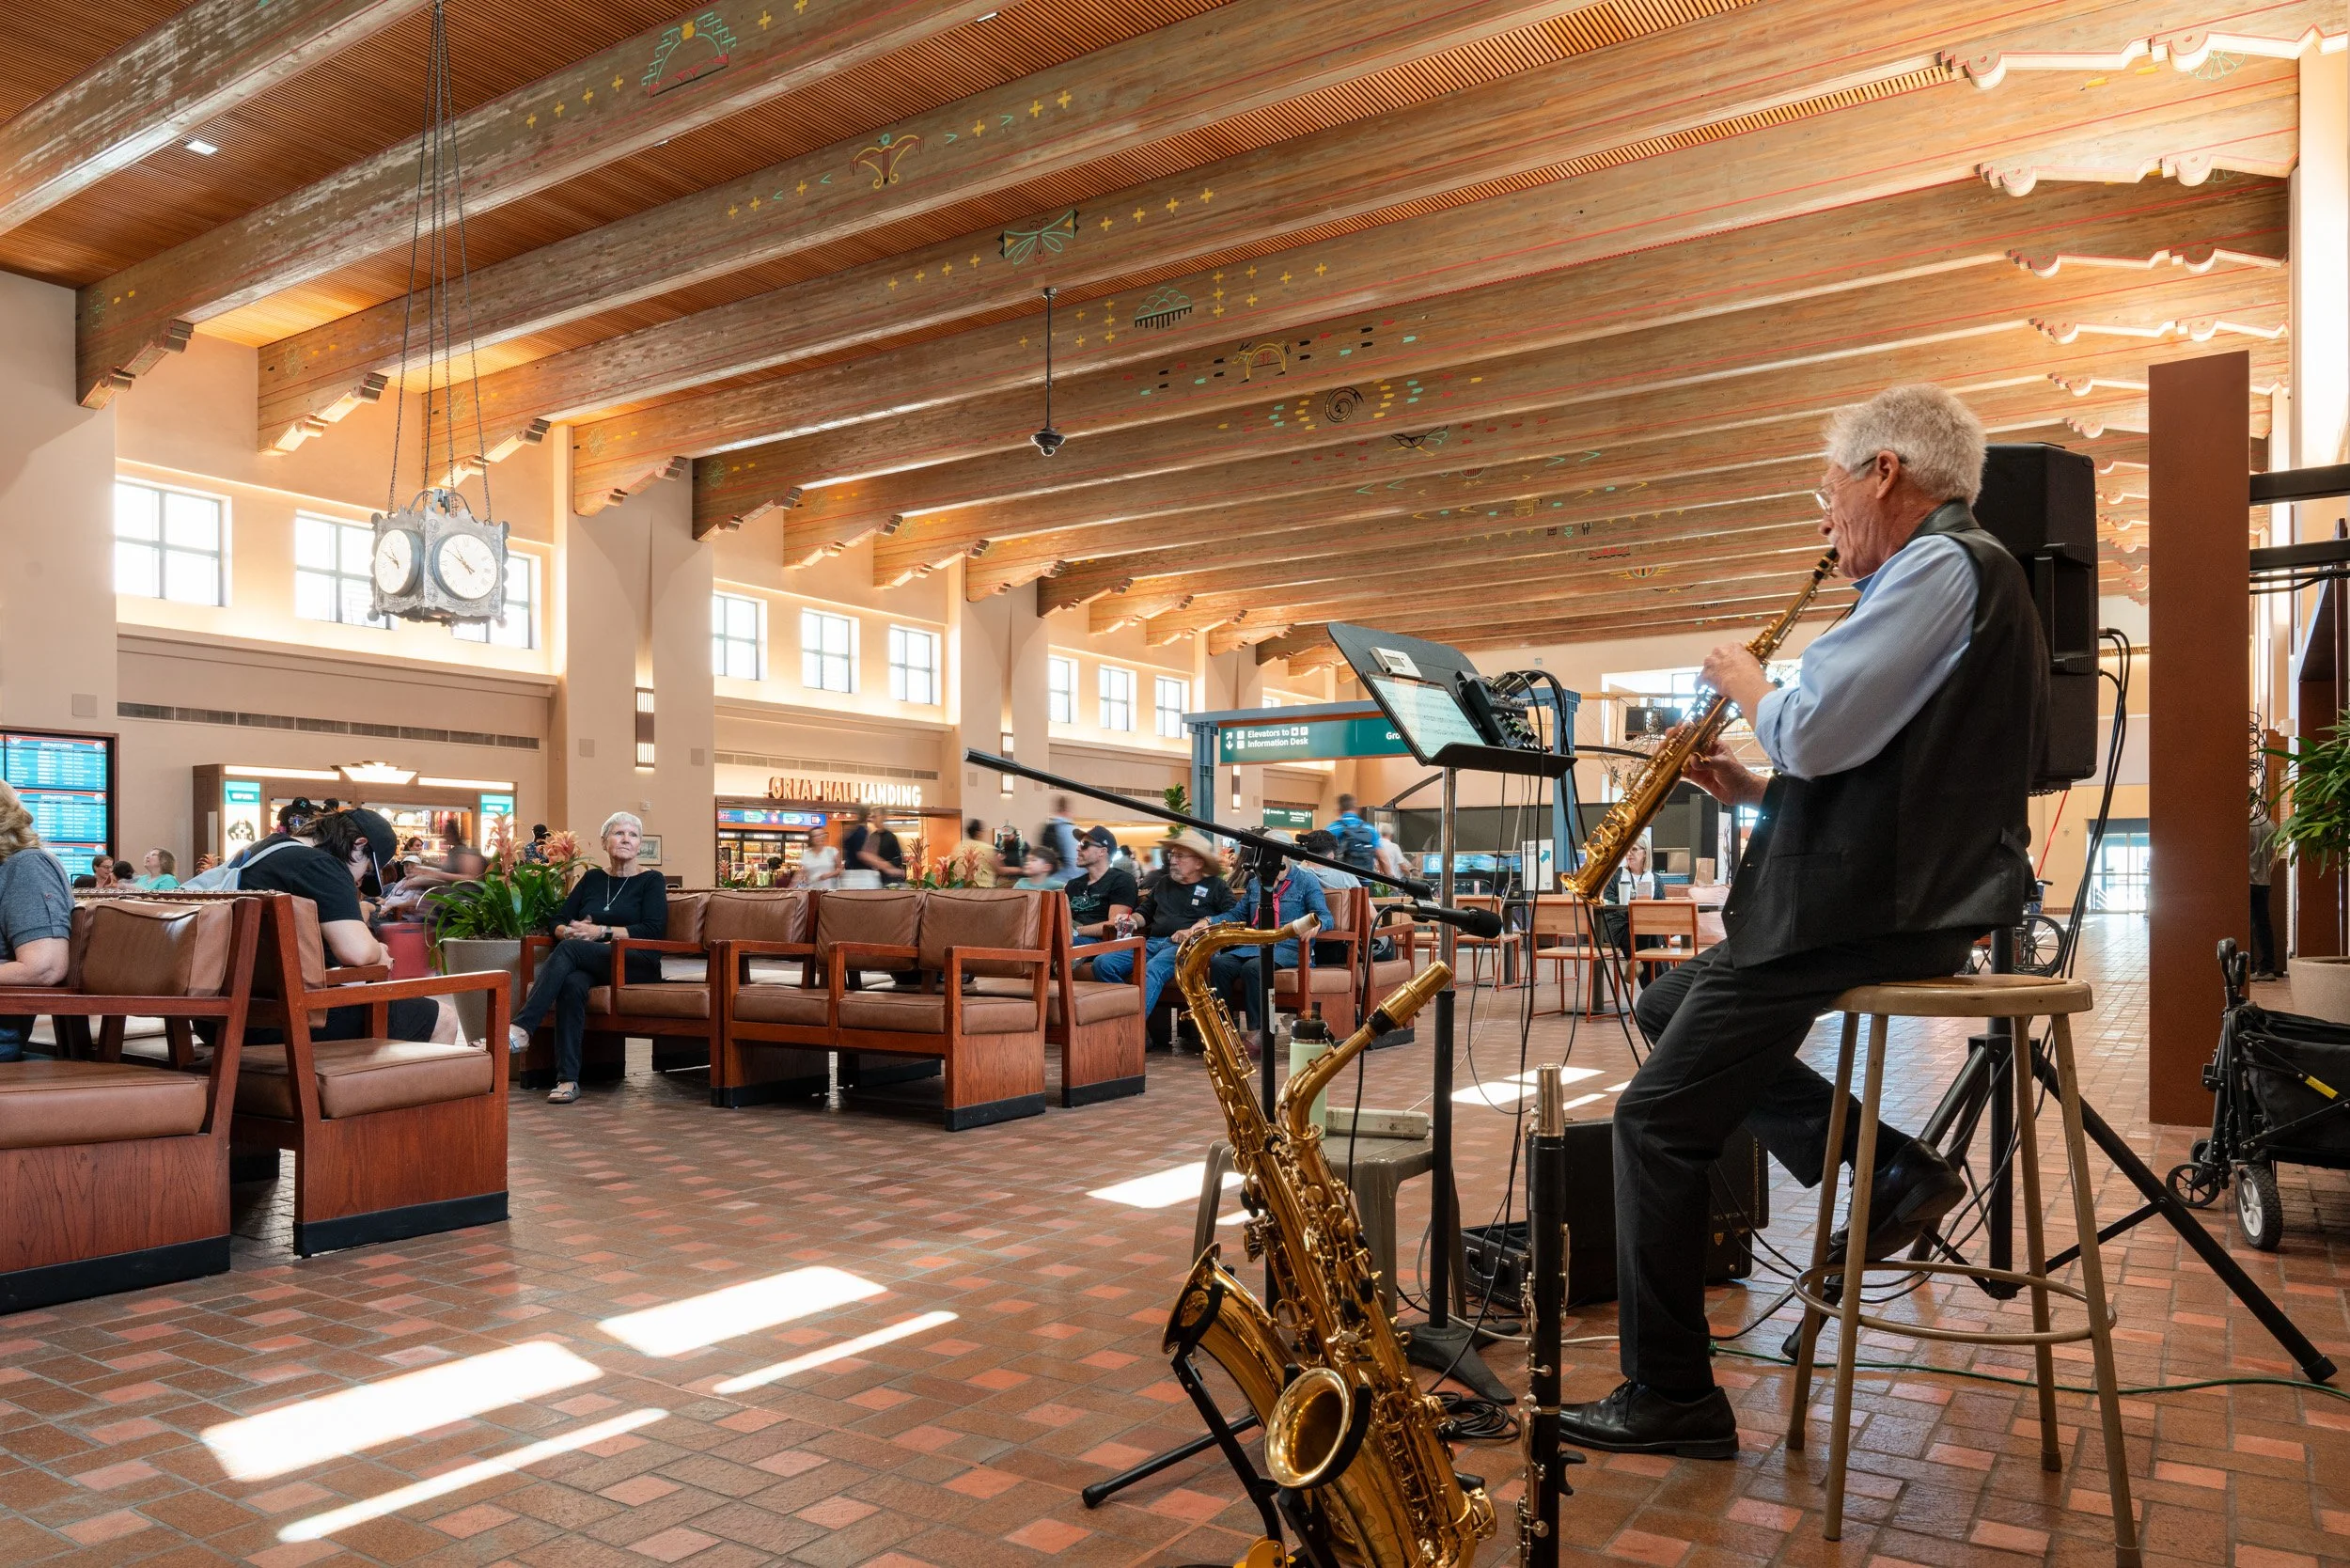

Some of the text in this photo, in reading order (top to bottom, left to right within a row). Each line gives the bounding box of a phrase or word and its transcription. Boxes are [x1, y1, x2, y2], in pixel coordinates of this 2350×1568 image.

[1247, 729, 1280, 738] Elevators
[1386, 731, 1401, 740] Gro
[1247, 737, 1308, 748] Information Desk
[770, 776, 921, 807] GREAT HALL LANDING
